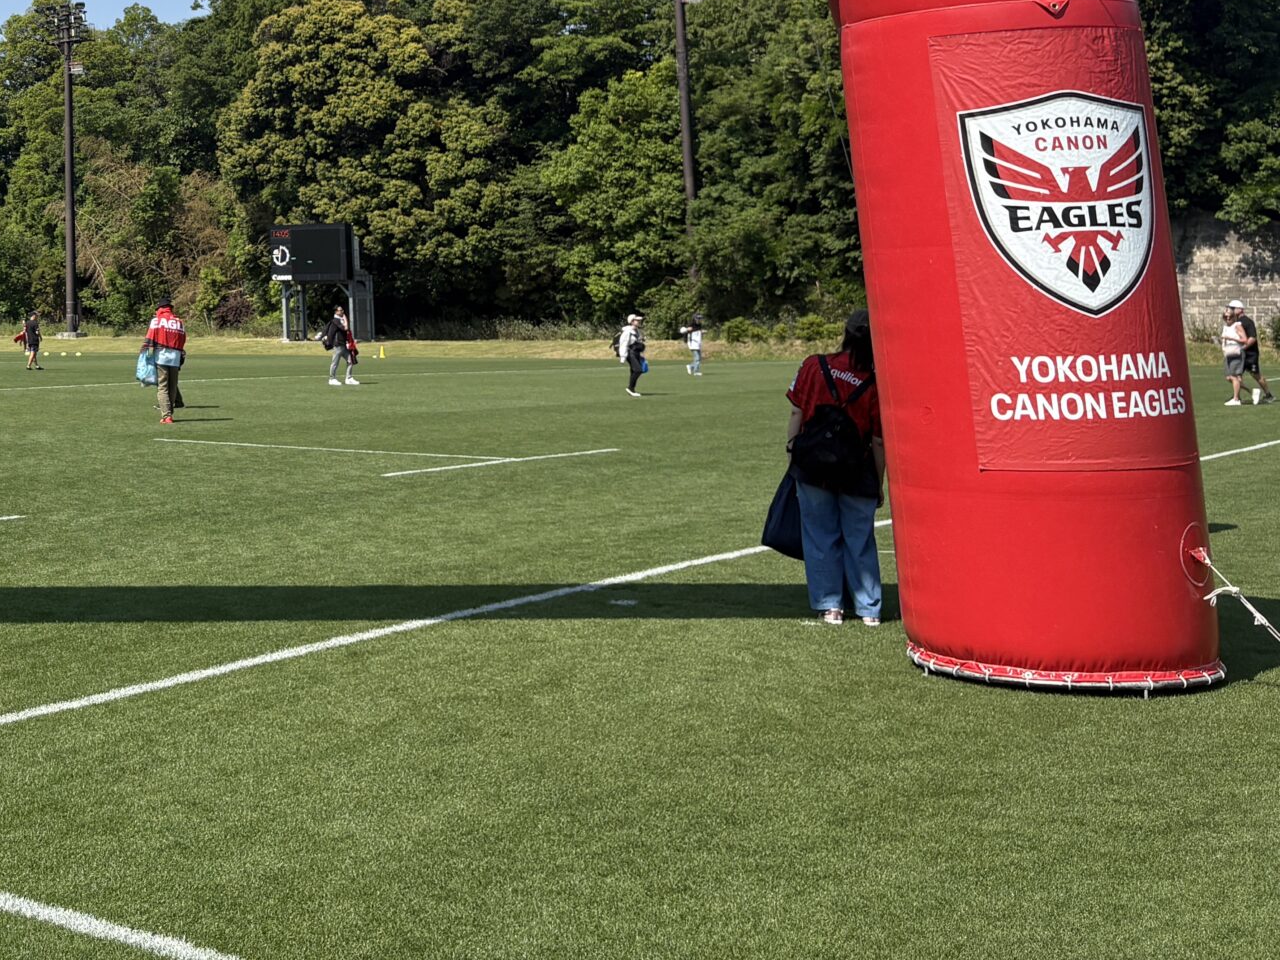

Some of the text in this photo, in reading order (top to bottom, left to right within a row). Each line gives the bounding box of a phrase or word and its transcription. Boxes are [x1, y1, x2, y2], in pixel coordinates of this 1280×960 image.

[1011, 116, 1120, 136] YOKOHAMA
[1035, 135, 1108, 152] CANON
[1001, 199, 1142, 233] EAGLES
[1011, 351, 1171, 383] YOKOHAMA
[990, 386, 1186, 421] CANON EAGLES
